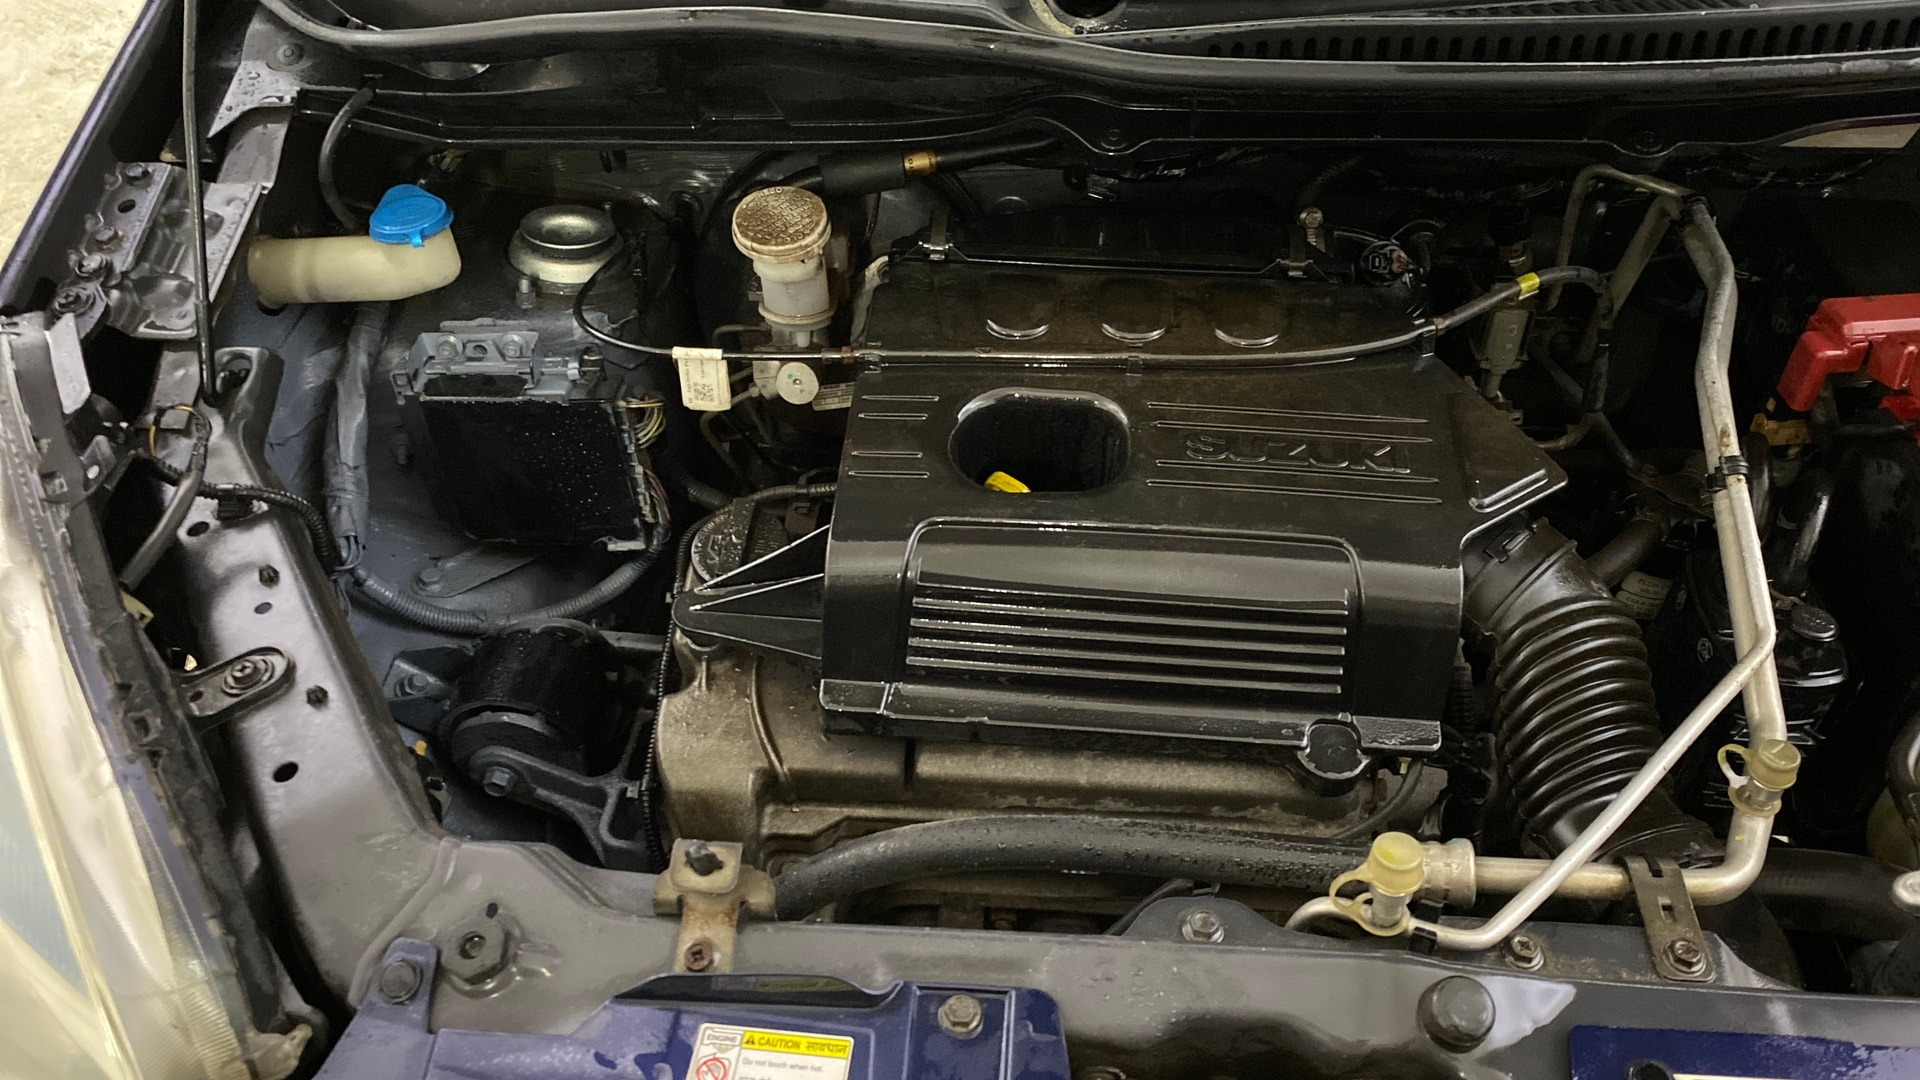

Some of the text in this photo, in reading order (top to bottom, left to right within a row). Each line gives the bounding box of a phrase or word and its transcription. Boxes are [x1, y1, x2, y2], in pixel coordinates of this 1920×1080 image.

[1186, 434, 1411, 474] SUZUKI
[706, 1033, 738, 1043] ENGINE
[758, 1037, 801, 1050] CAUTION
[742, 1057, 752, 1066] Do
[789, 1062, 808, 1070] when
